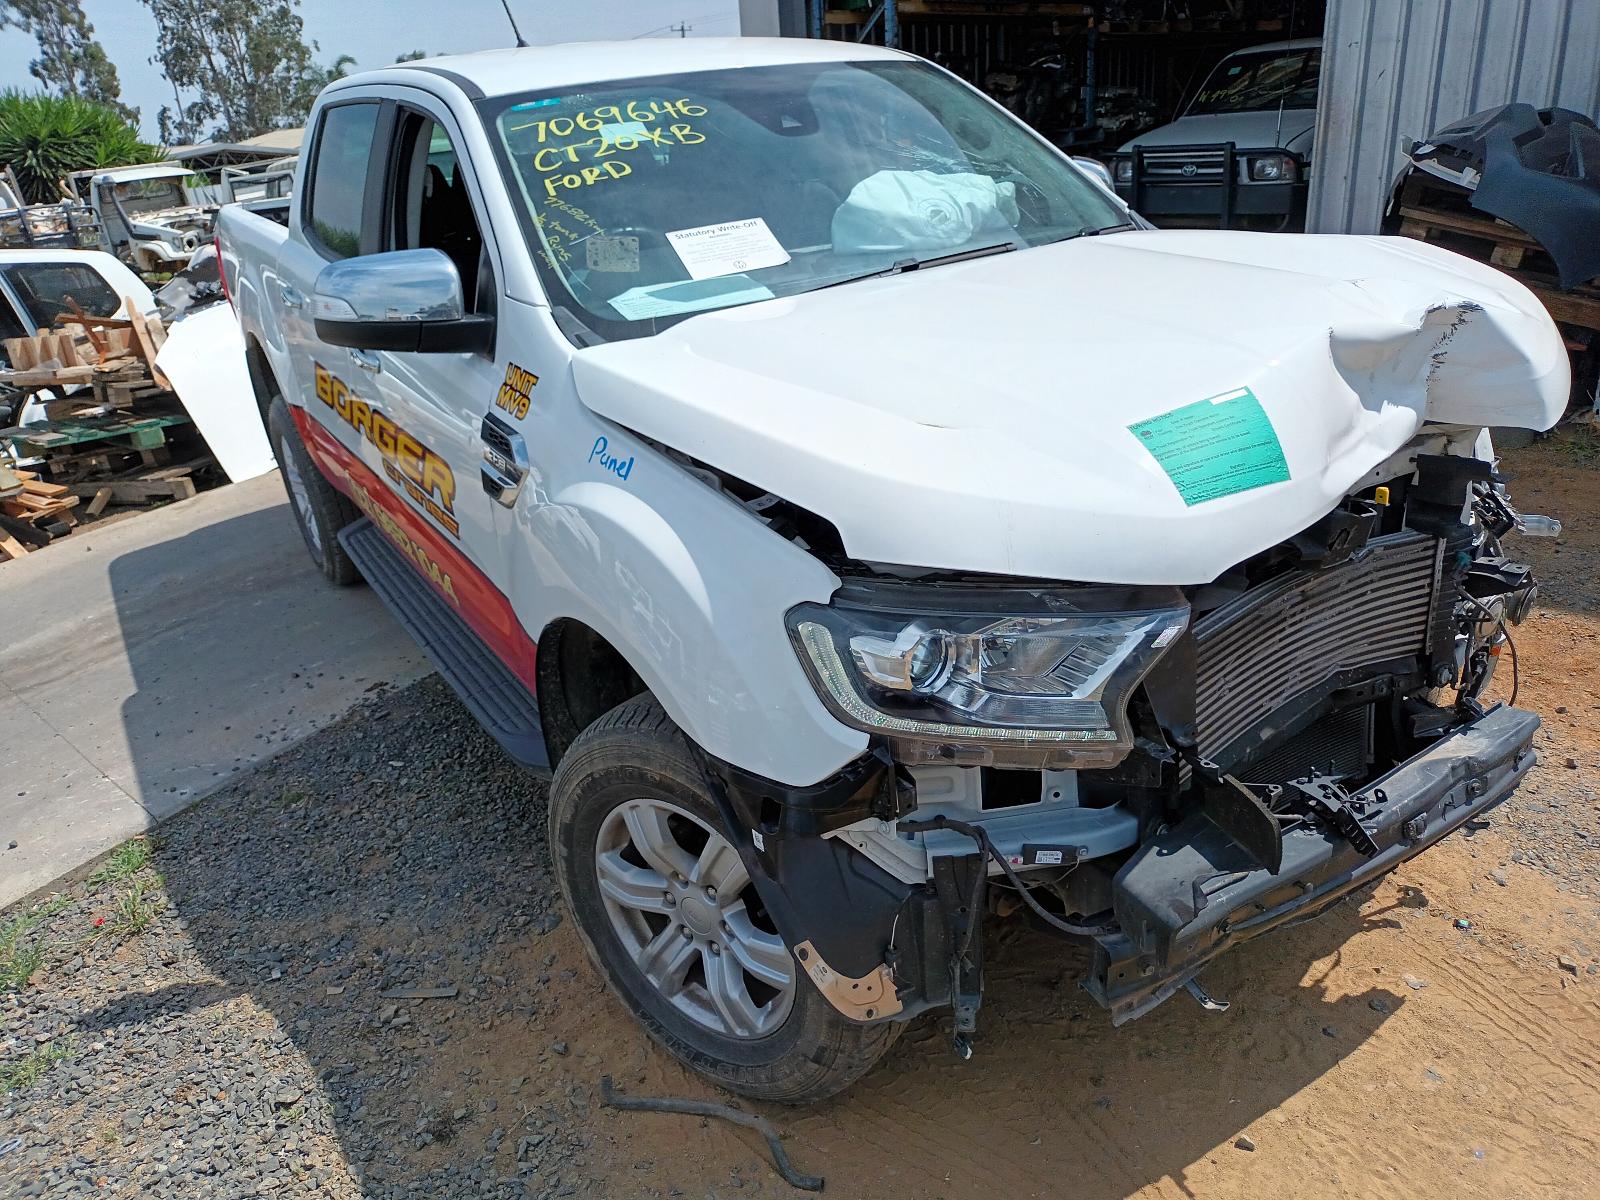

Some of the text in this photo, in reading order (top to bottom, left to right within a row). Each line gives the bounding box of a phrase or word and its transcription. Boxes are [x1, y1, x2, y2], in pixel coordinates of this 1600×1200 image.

[543, 160, 633, 196] FORD
[674, 228, 716, 240] Statutory
[717, 220, 759, 233] Write-Off
[505, 362, 540, 398] UNIT
[496, 382, 531, 421] MV9
[314, 361, 457, 518] BORGER
[588, 436, 634, 481] Panel
